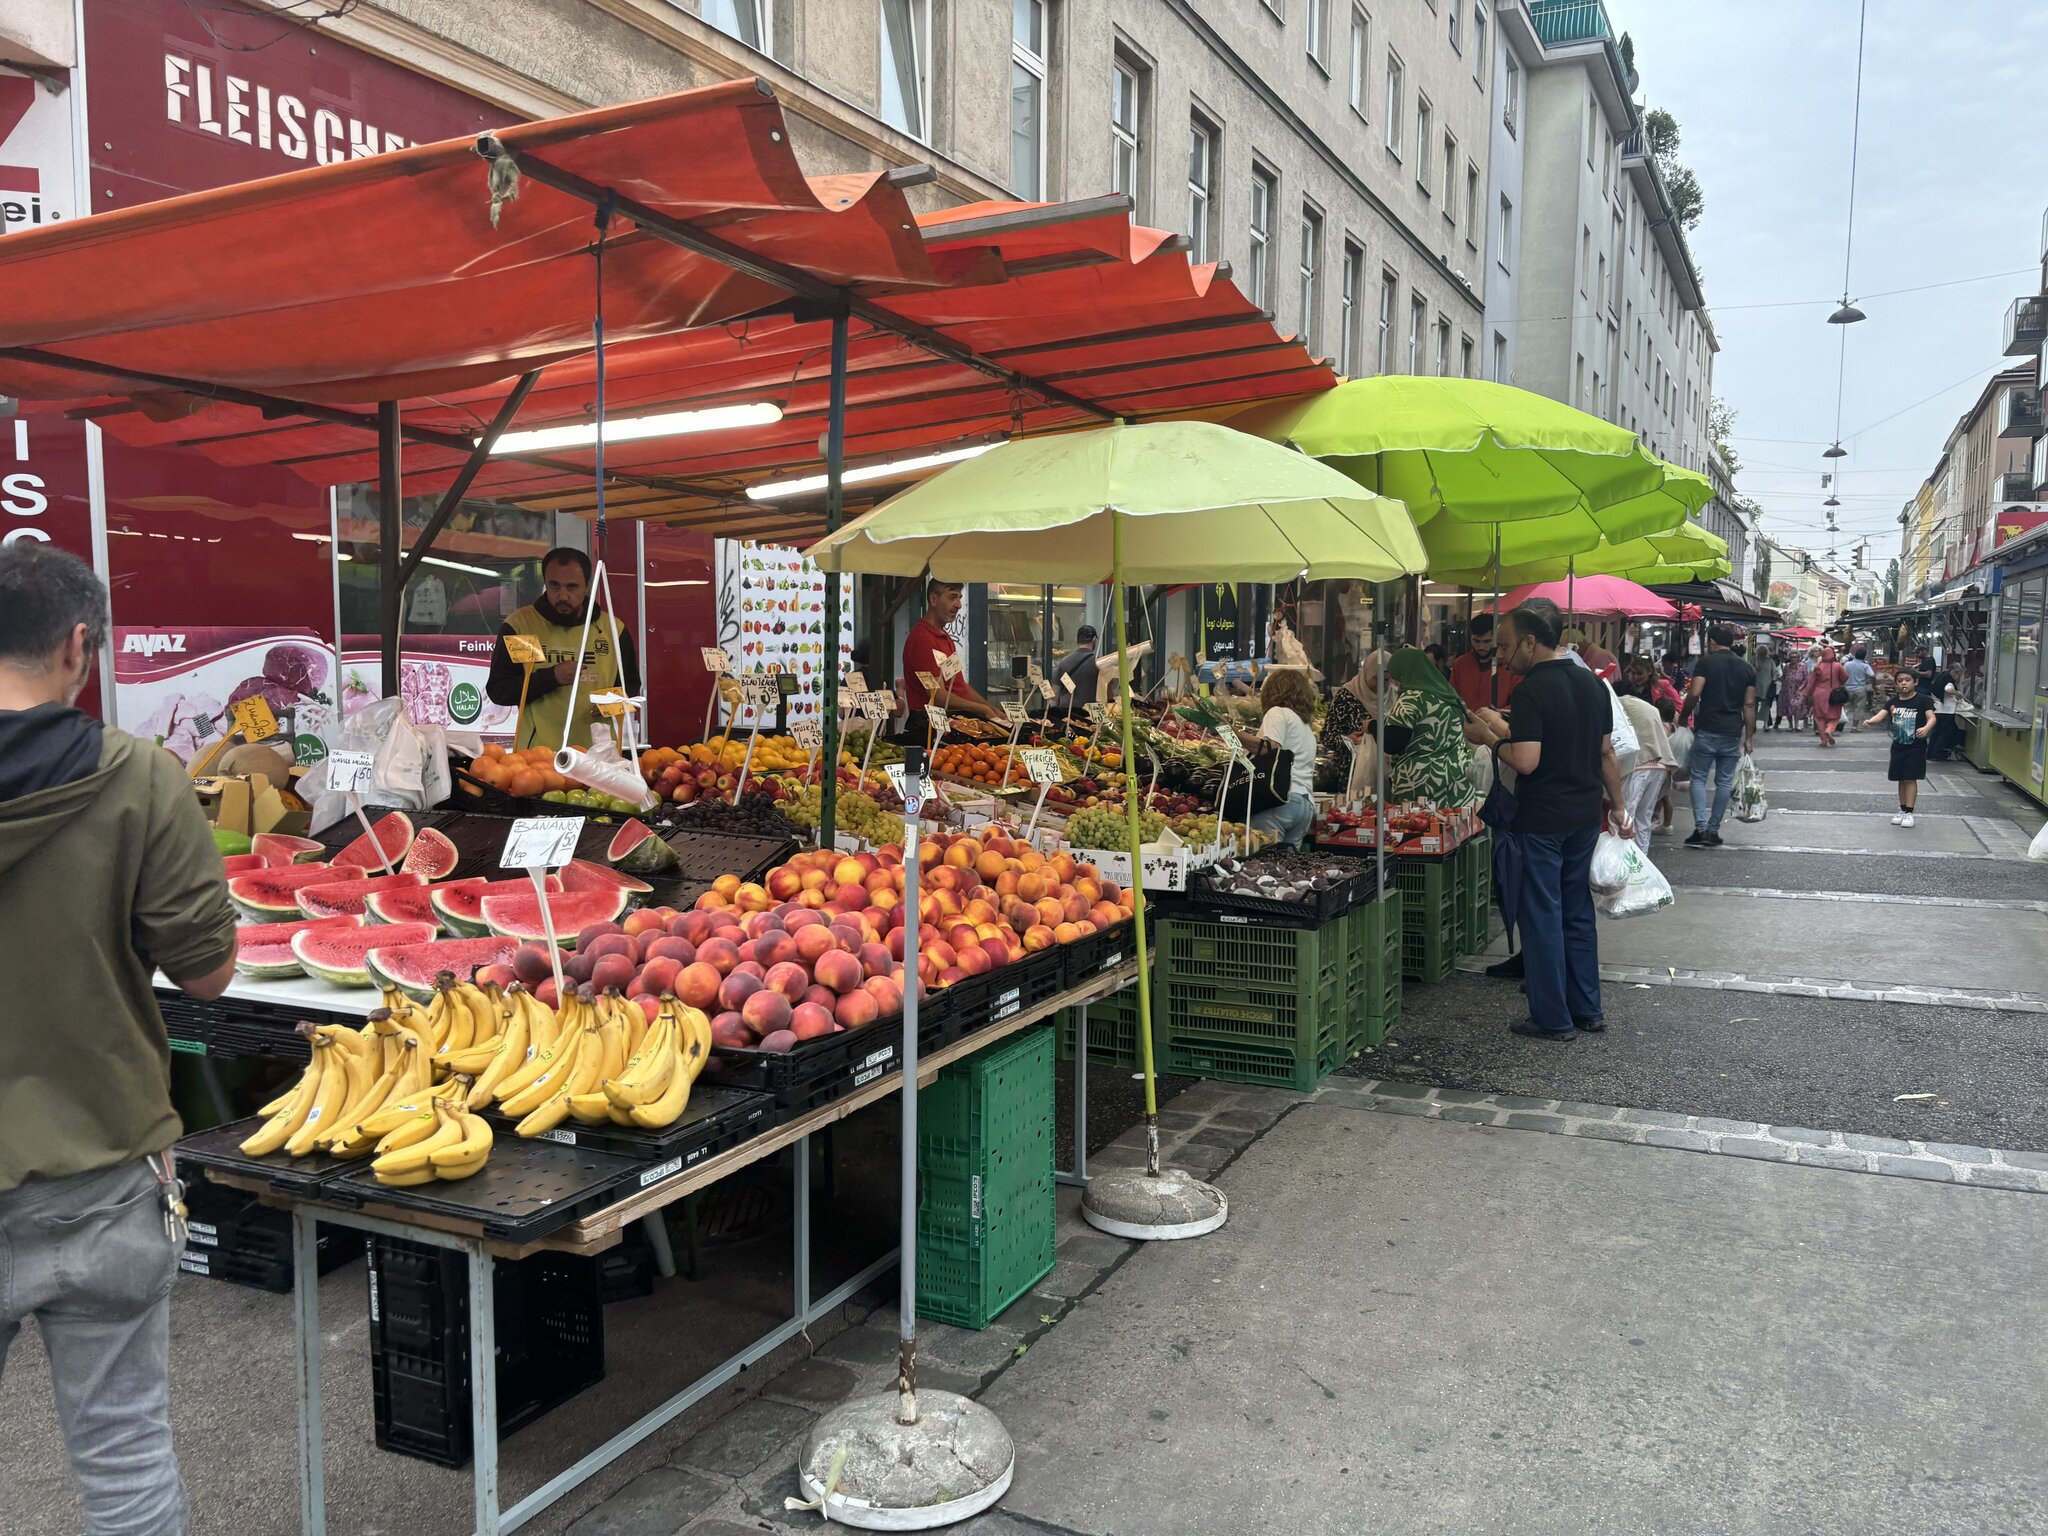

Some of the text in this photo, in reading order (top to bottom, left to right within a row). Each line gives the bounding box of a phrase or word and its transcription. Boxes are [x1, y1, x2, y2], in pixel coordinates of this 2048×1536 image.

[122, 634, 187, 657] AYAZ
[454, 689, 478, 704] حلال
[456, 703, 476, 711] HALAL
